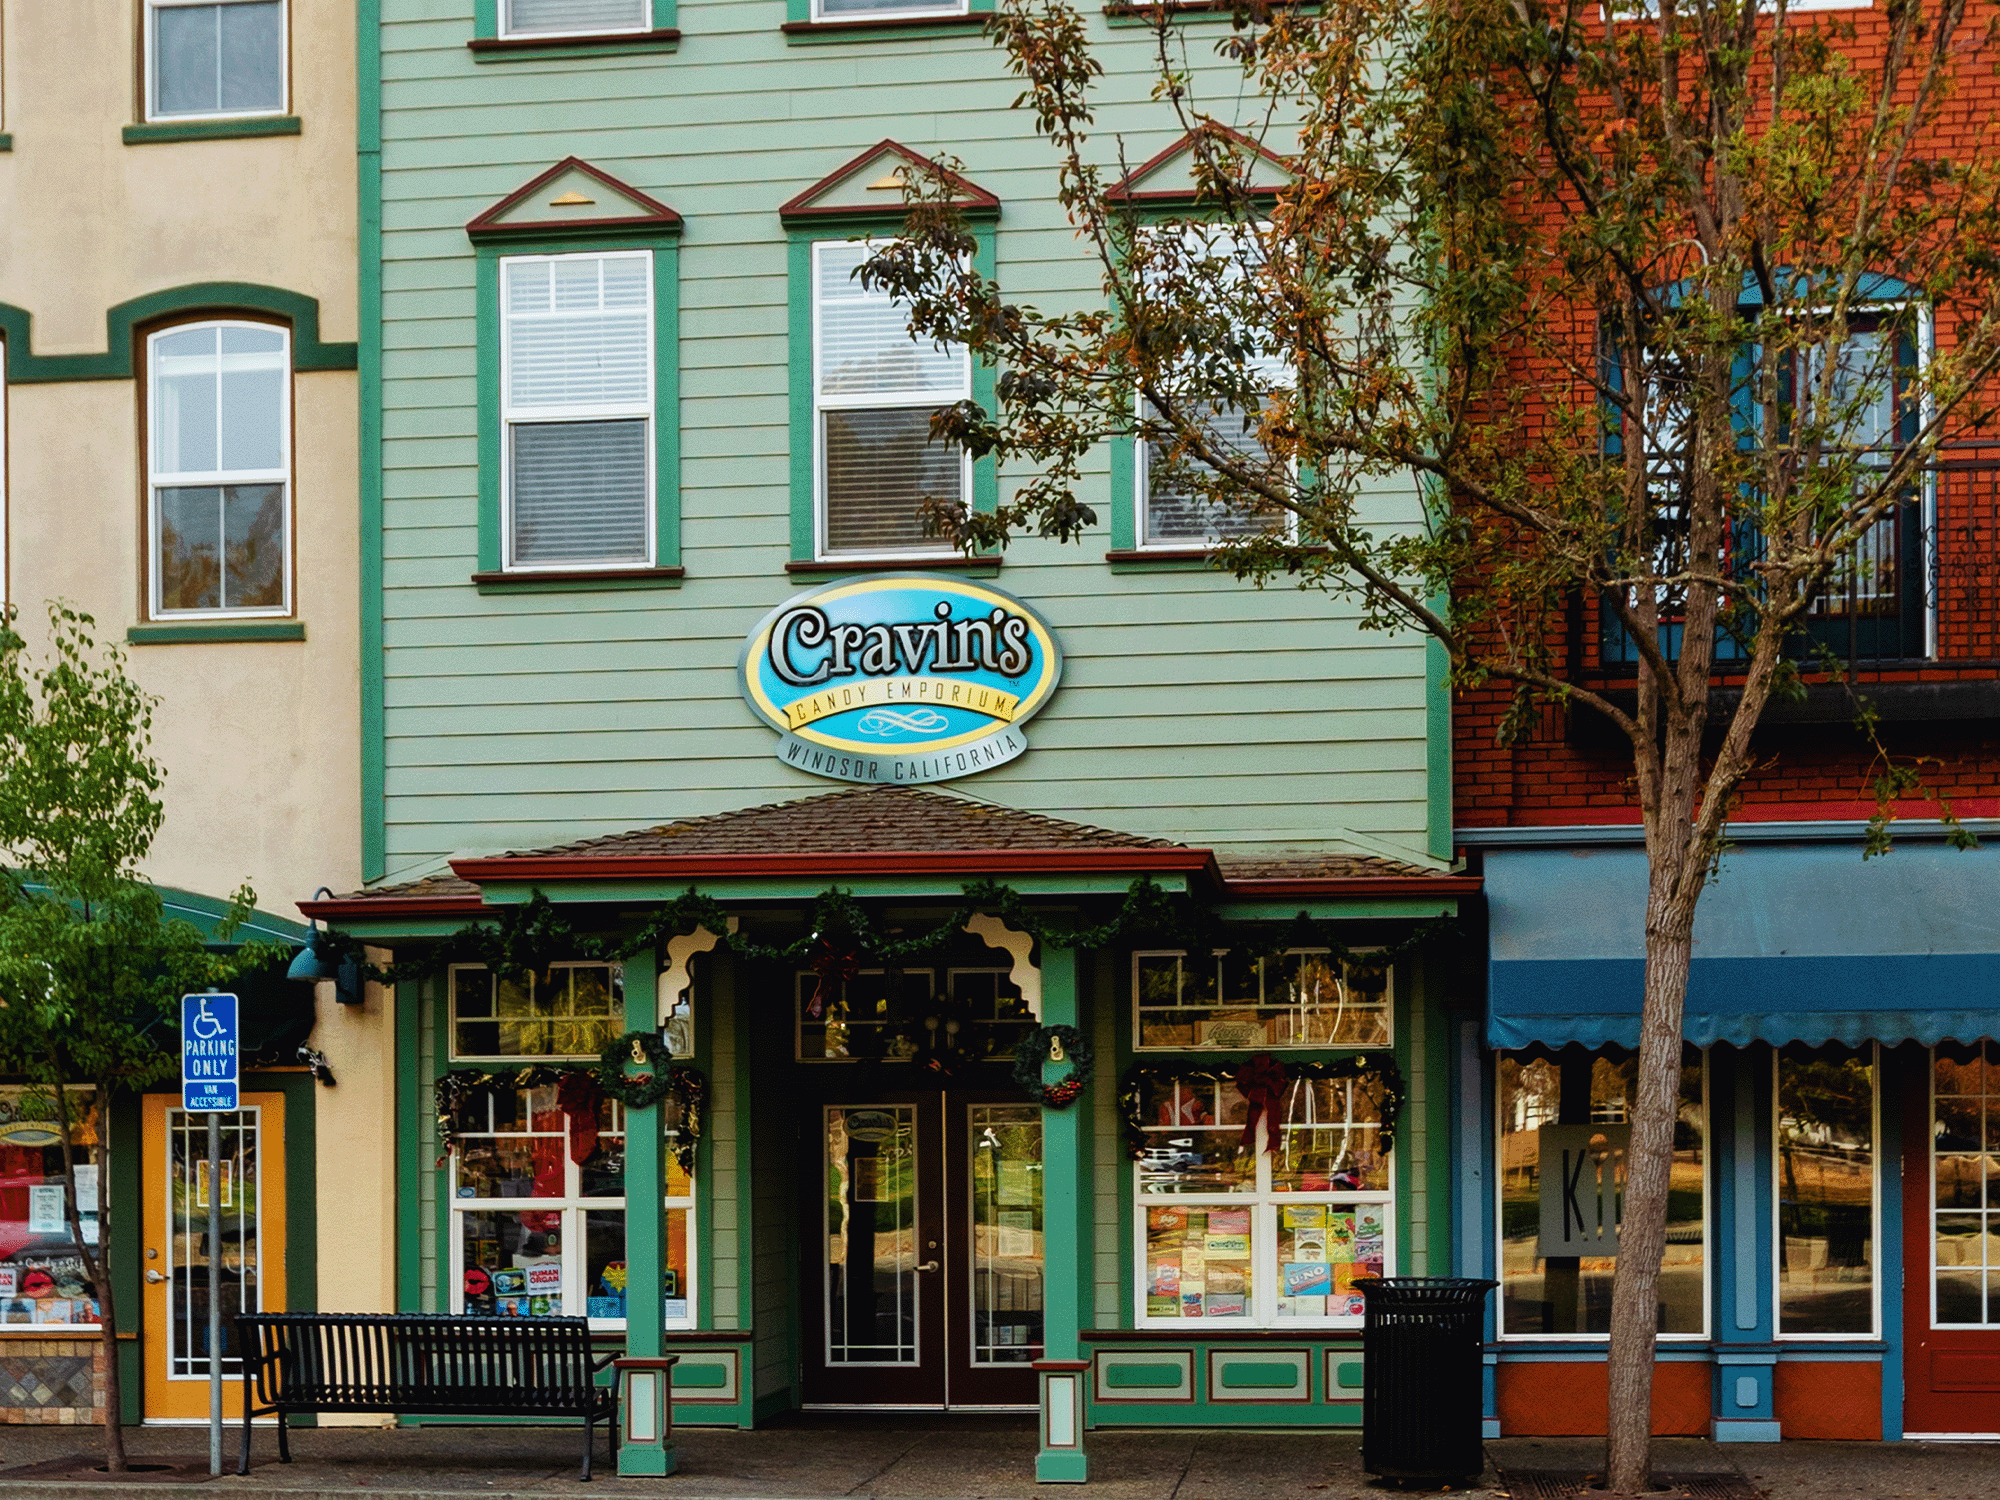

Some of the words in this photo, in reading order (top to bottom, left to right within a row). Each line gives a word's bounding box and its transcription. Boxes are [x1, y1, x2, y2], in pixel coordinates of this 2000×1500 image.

[768, 601, 1033, 686] Cravin's
[796, 685, 867, 720] CANDY
[886, 681, 1007, 714] EMPORIUM
[788, 742, 878, 780] WINDSOR
[895, 735, 1018, 780] CALIFORNIA
[185, 1039, 235, 1056] PARKING
[192, 1059, 228, 1076] ONLY
[203, 1085, 219, 1095] VAN
[189, 1096, 233, 1108] ACCESSIBLE
[529, 1269, 559, 1278] HUMAN
[530, 1275, 560, 1284] ORGAN
